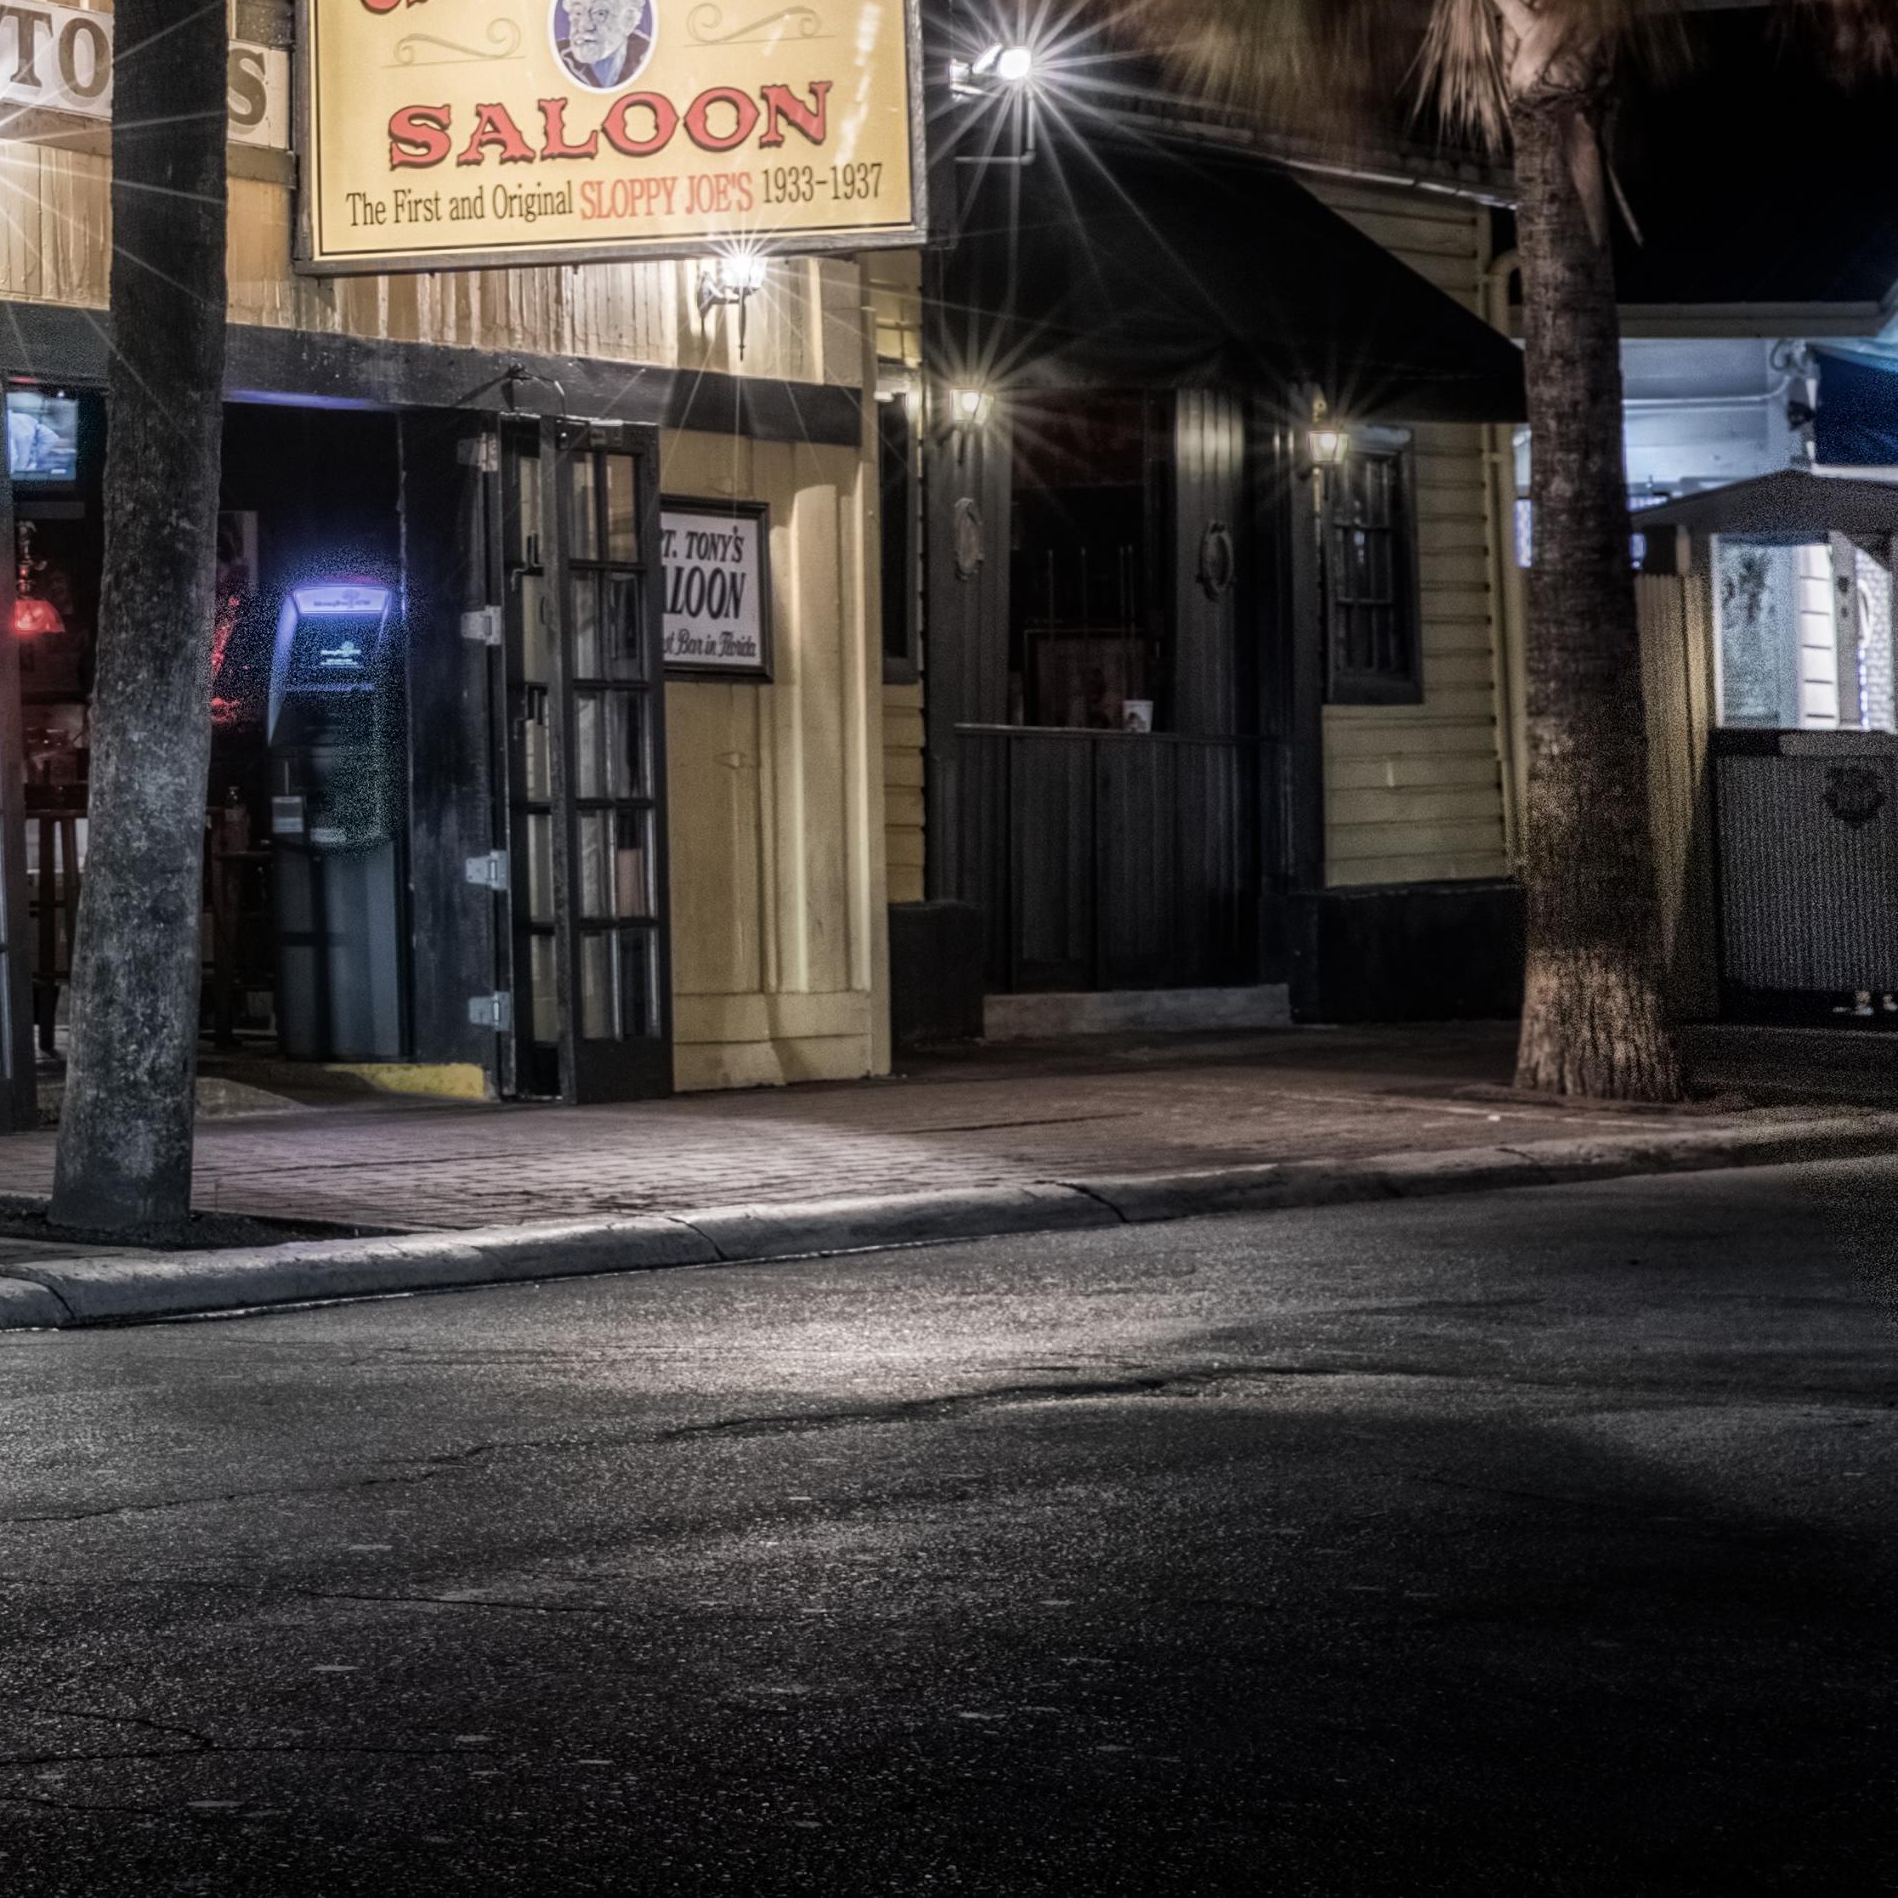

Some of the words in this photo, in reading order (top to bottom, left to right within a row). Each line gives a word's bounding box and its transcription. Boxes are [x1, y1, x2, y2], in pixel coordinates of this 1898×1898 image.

[387, 79, 834, 172] SALOON
[346, 191, 387, 227] The
[393, 186, 443, 224] First
[449, 185, 486, 220] and
[491, 180, 575, 225] Original
[579, 176, 679, 223] SLOPPY
[684, 172, 754, 214] JOE'S
[761, 162, 883, 204] 1933-1937
[685, 525, 746, 564] TONY'S
[661, 565, 748, 621] LOON
[675, 628, 703, 656] Bar
[704, 634, 717, 656] in
[718, 630, 757, 658] Florida
